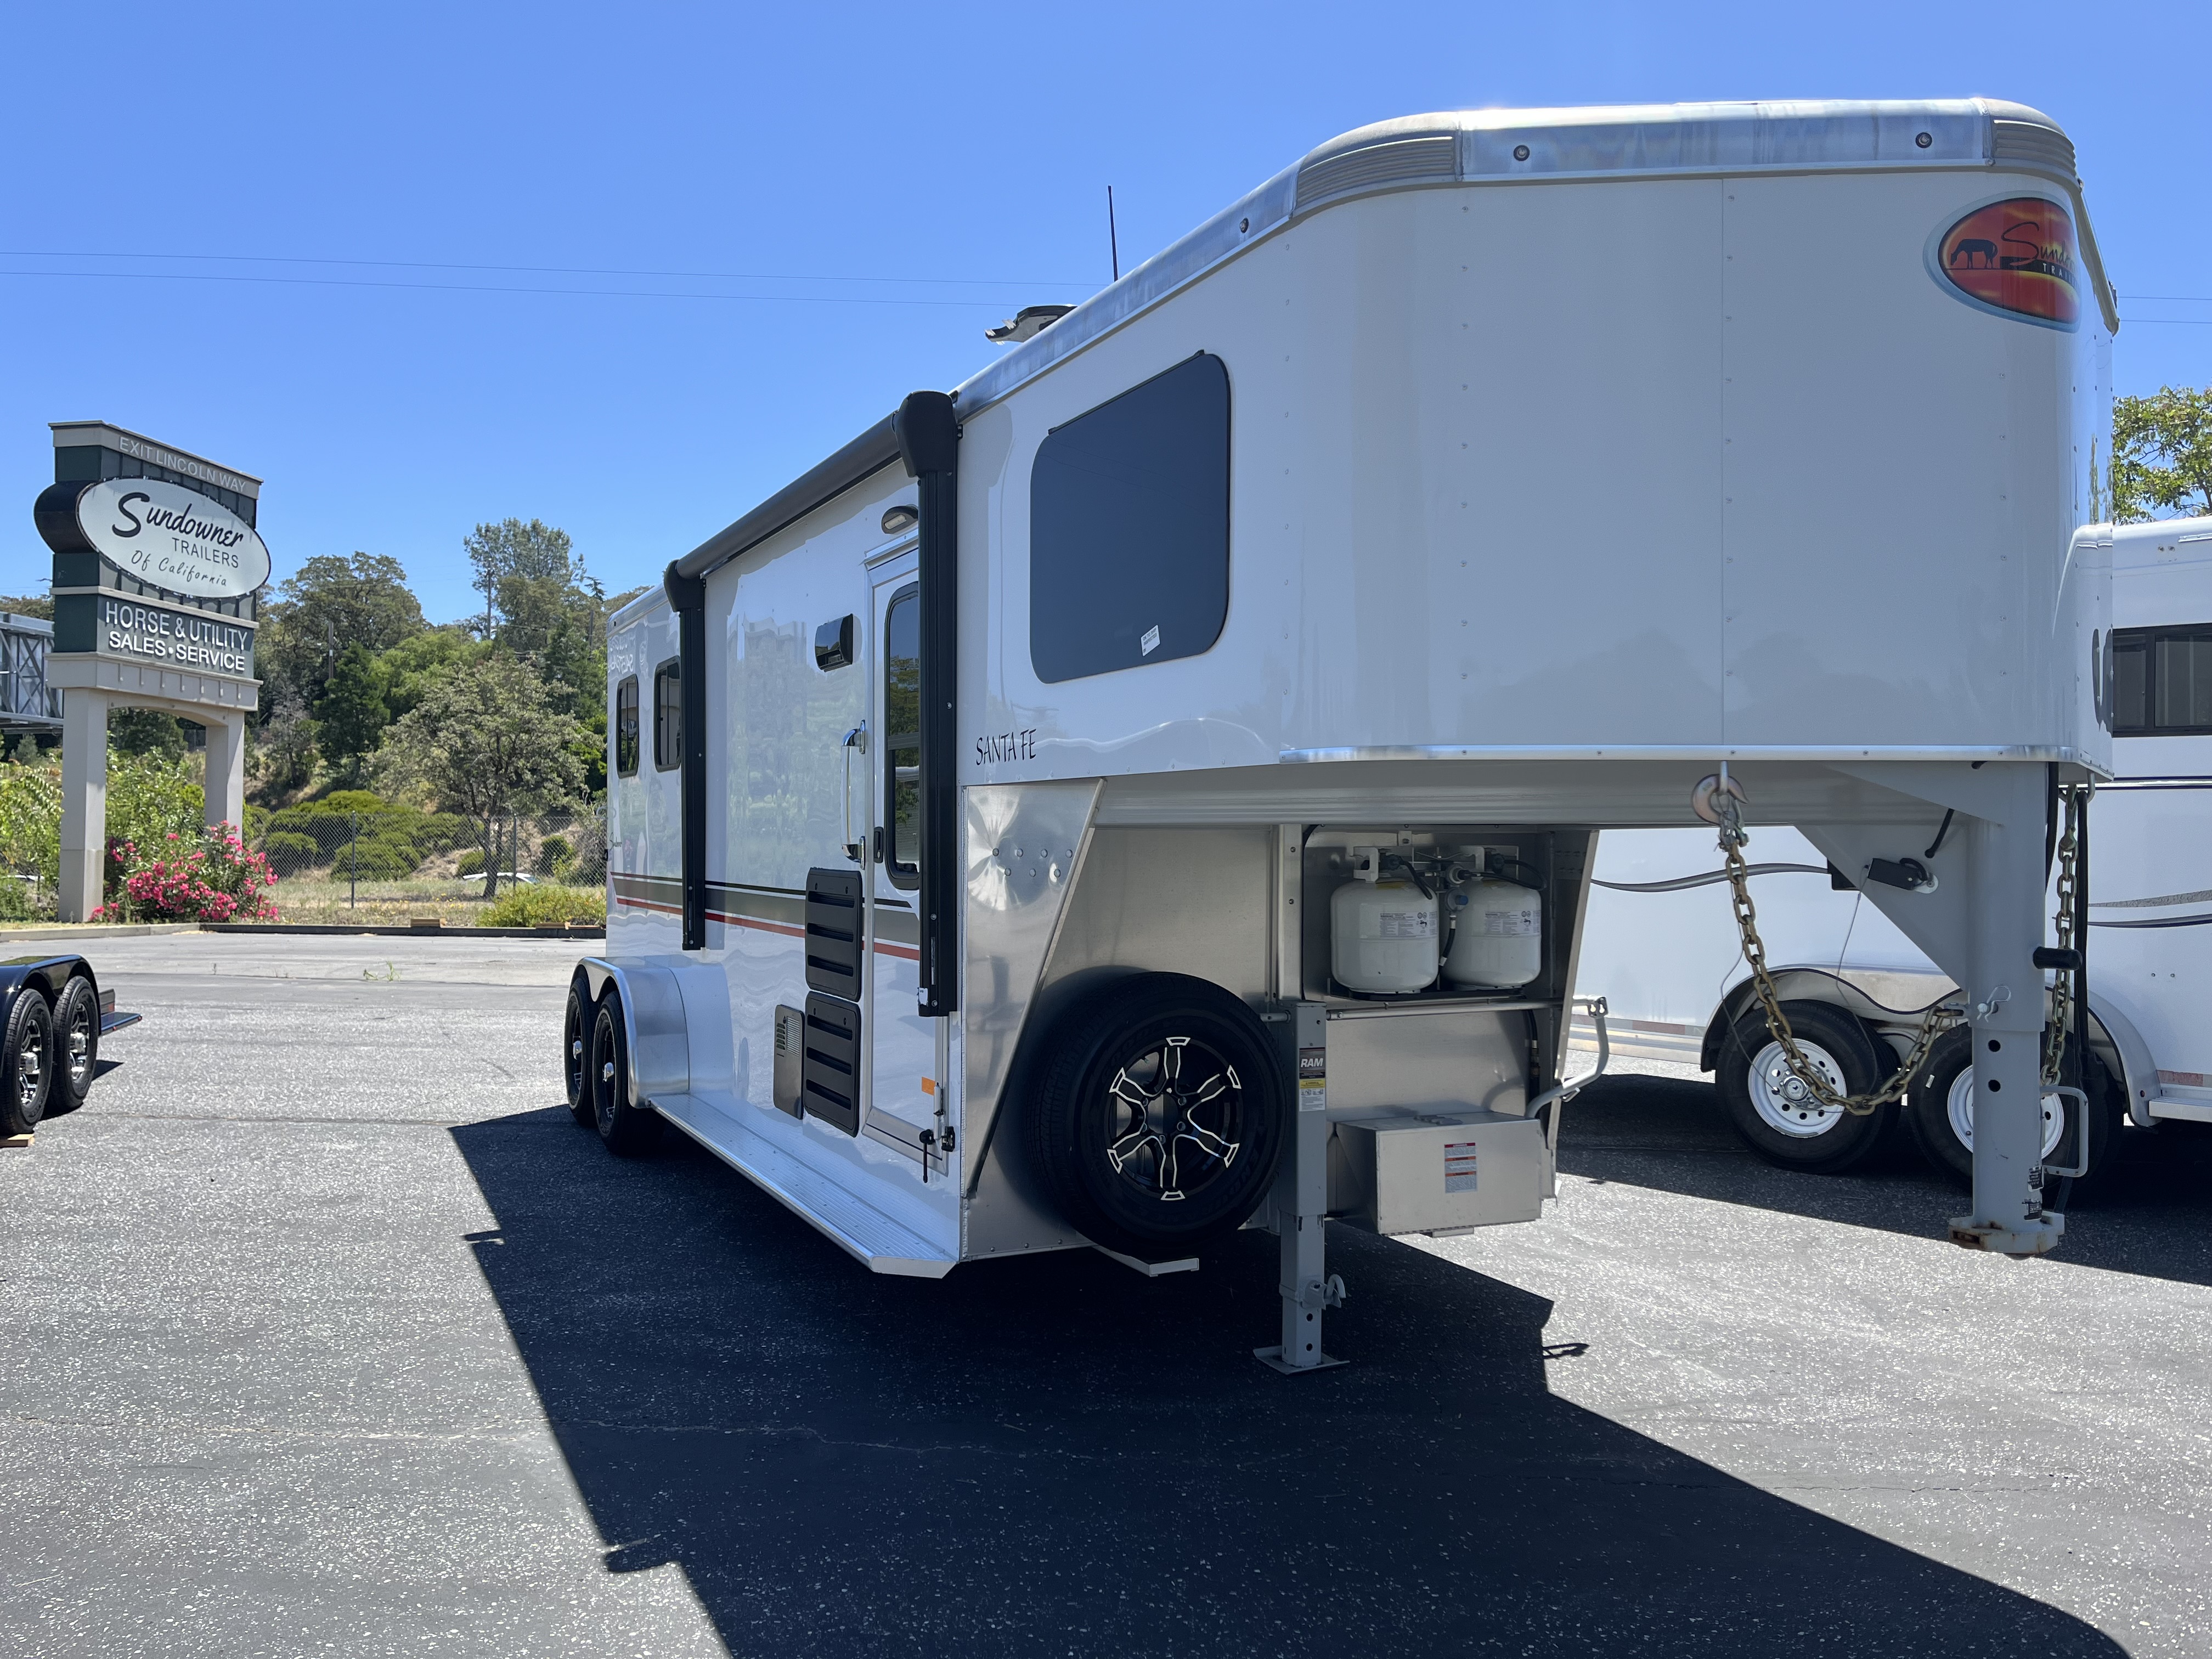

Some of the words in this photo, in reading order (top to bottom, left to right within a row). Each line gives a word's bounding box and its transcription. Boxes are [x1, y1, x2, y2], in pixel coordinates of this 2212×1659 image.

[120, 436, 153, 459] EXIT
[156, 450, 216, 482] LINCOLN
[219, 473, 246, 493] WAY
[112, 492, 244, 547] Sundowner
[131, 550, 150, 571] Of
[159, 557, 227, 586] California
[172, 537, 239, 568] TRAILERS
[106, 601, 170, 635] HORSE
[175, 617, 186, 639] &
[190, 620, 247, 651] UTILITY
[976, 731, 1017, 766] SANTA
[1020, 729, 1036, 761] FE
[1300, 1058, 1324, 1068] RAM
